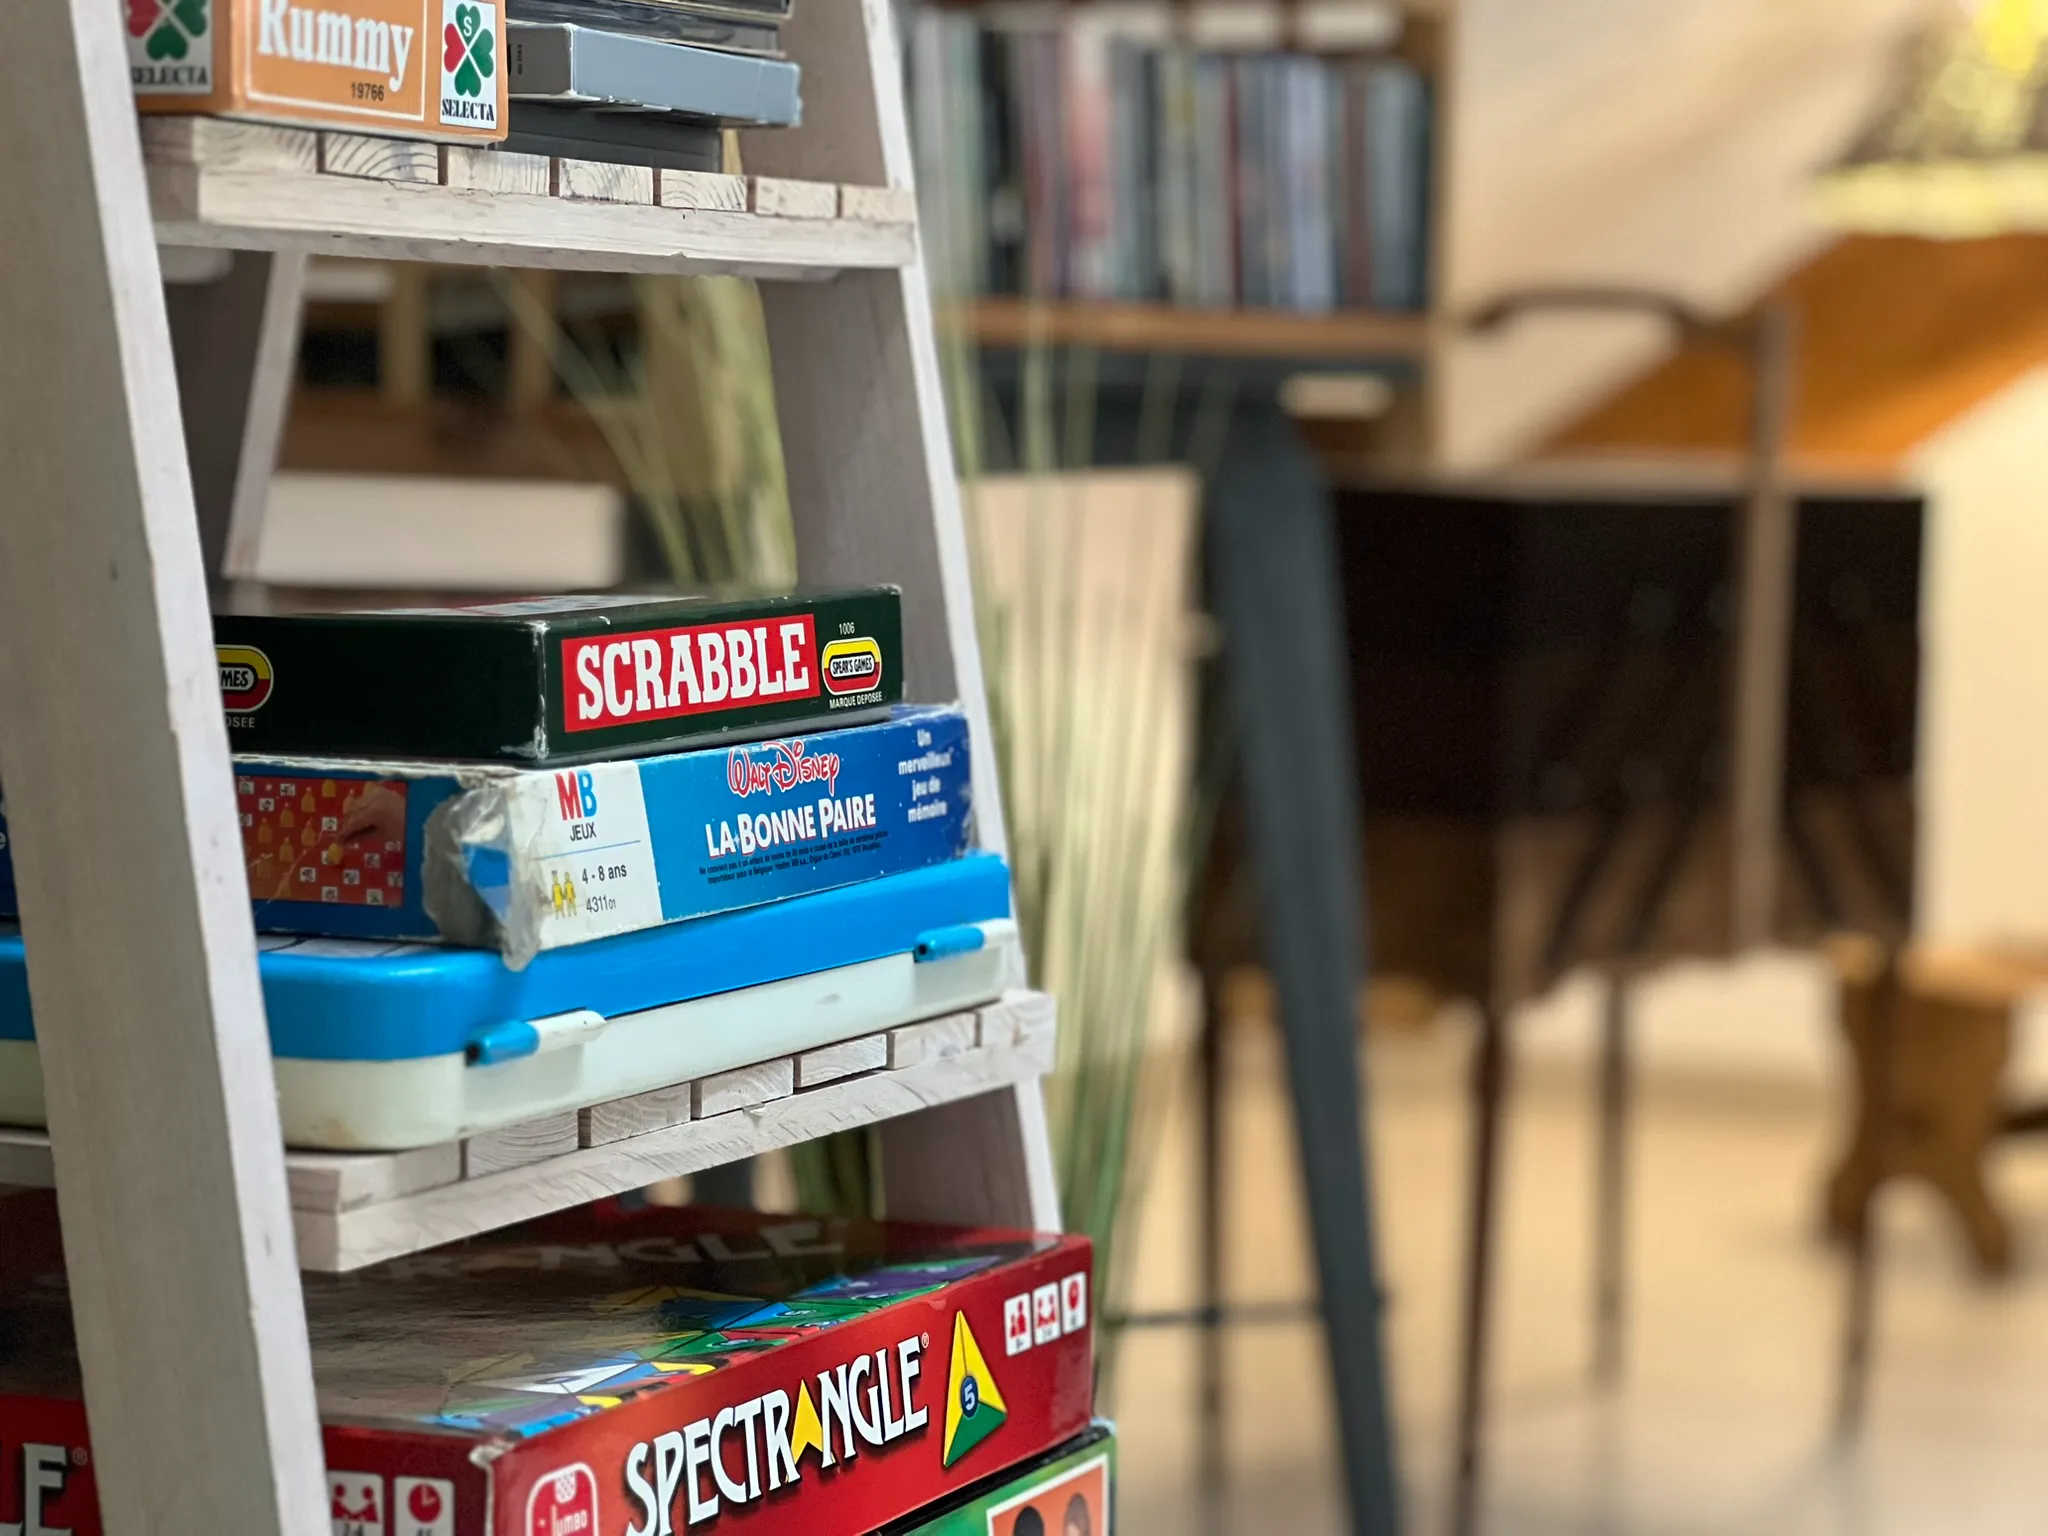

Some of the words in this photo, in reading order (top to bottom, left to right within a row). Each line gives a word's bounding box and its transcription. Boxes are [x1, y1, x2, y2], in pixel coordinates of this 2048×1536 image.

[257, 0, 414, 92] Rummy
[351, 82, 385, 101] 19766
[441, 99, 494, 121] SELECTA
[839, 622, 855, 635] 1006
[577, 623, 810, 720] SCRABBLE
[832, 660, 853, 675] SPEAR'S
[854, 657, 872, 672] GAMES
[221, 670, 249, 687] MES
[829, 697, 856, 709] MARQUE
[555, 770, 597, 821] MB
[570, 822, 597, 841] JEUX
[705, 820, 736, 858] LA
[737, 804, 816, 856] BONNE
[818, 793, 876, 838] PAIRE
[582, 868, 589, 884] 4
[598, 865, 605, 881] 8
[608, 863, 628, 879] ans
[964, 1383, 975, 1410] 5
[625, 1336, 929, 1536] SPECTRANGLE
